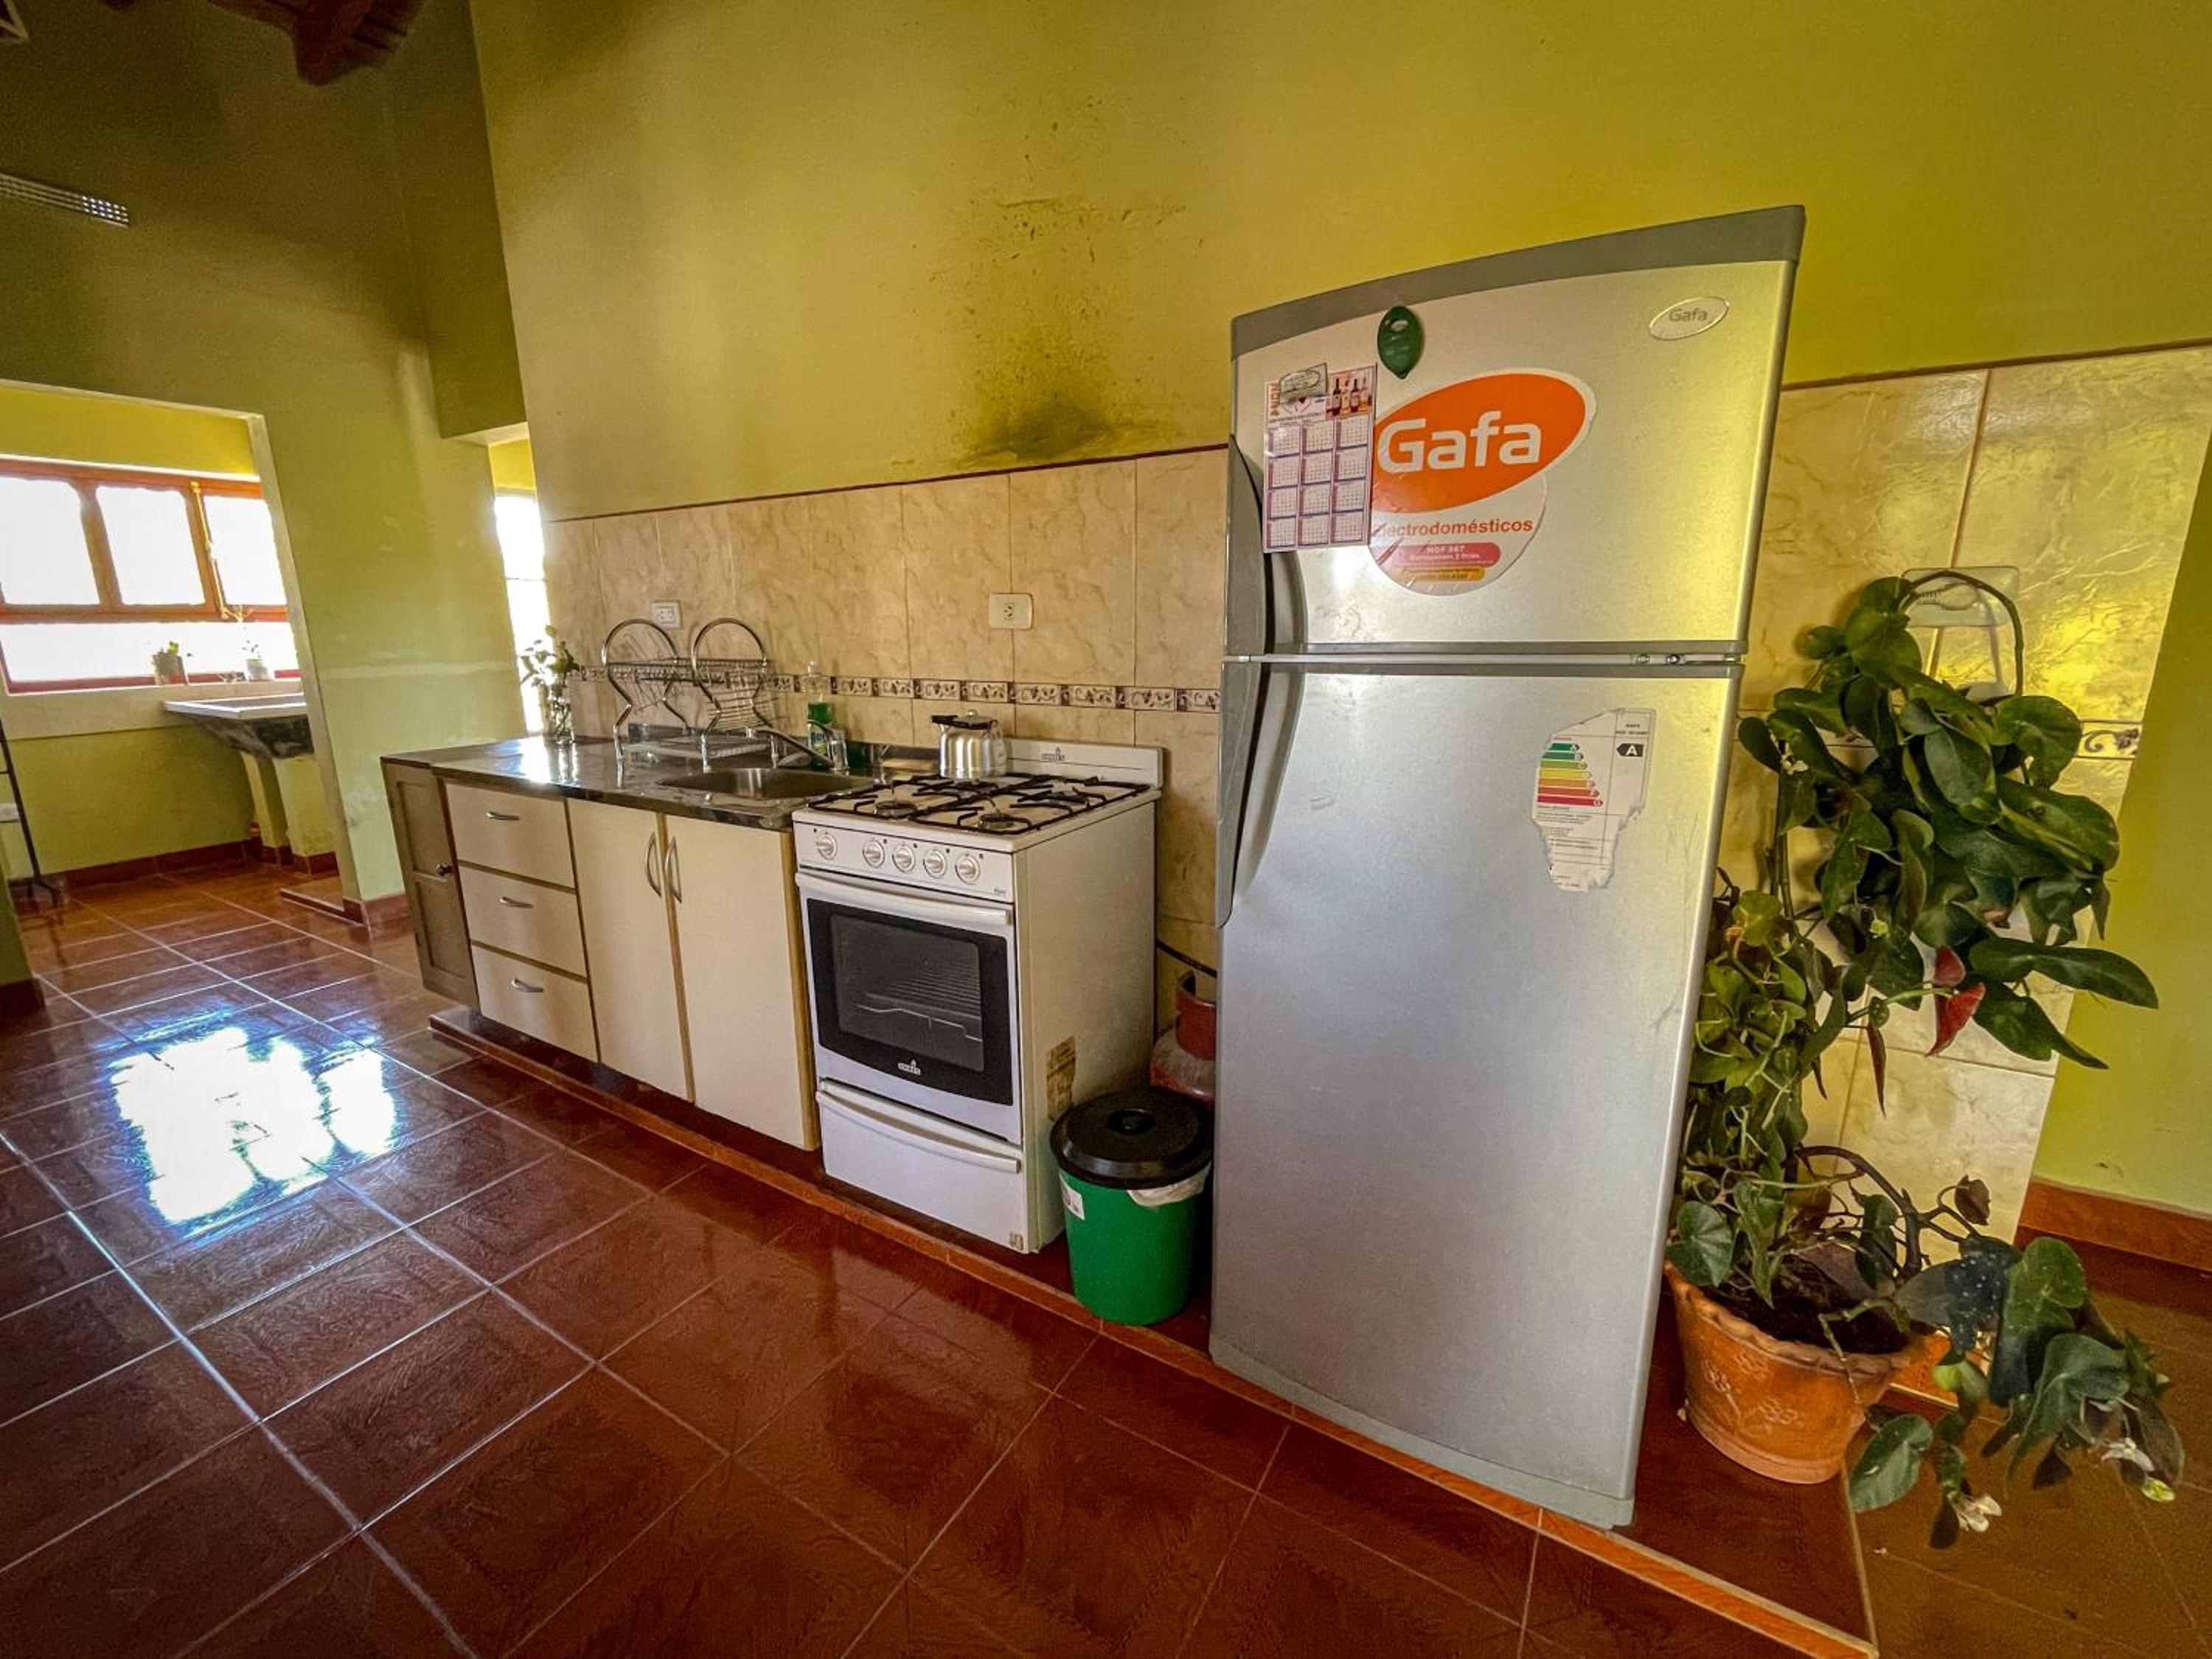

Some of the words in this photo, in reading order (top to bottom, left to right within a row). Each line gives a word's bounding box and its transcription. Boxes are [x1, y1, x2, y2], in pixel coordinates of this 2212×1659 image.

[1669, 307, 1708, 322] Gafa
[1377, 410, 1542, 473] Gafa
[1626, 745, 1638, 756] A
